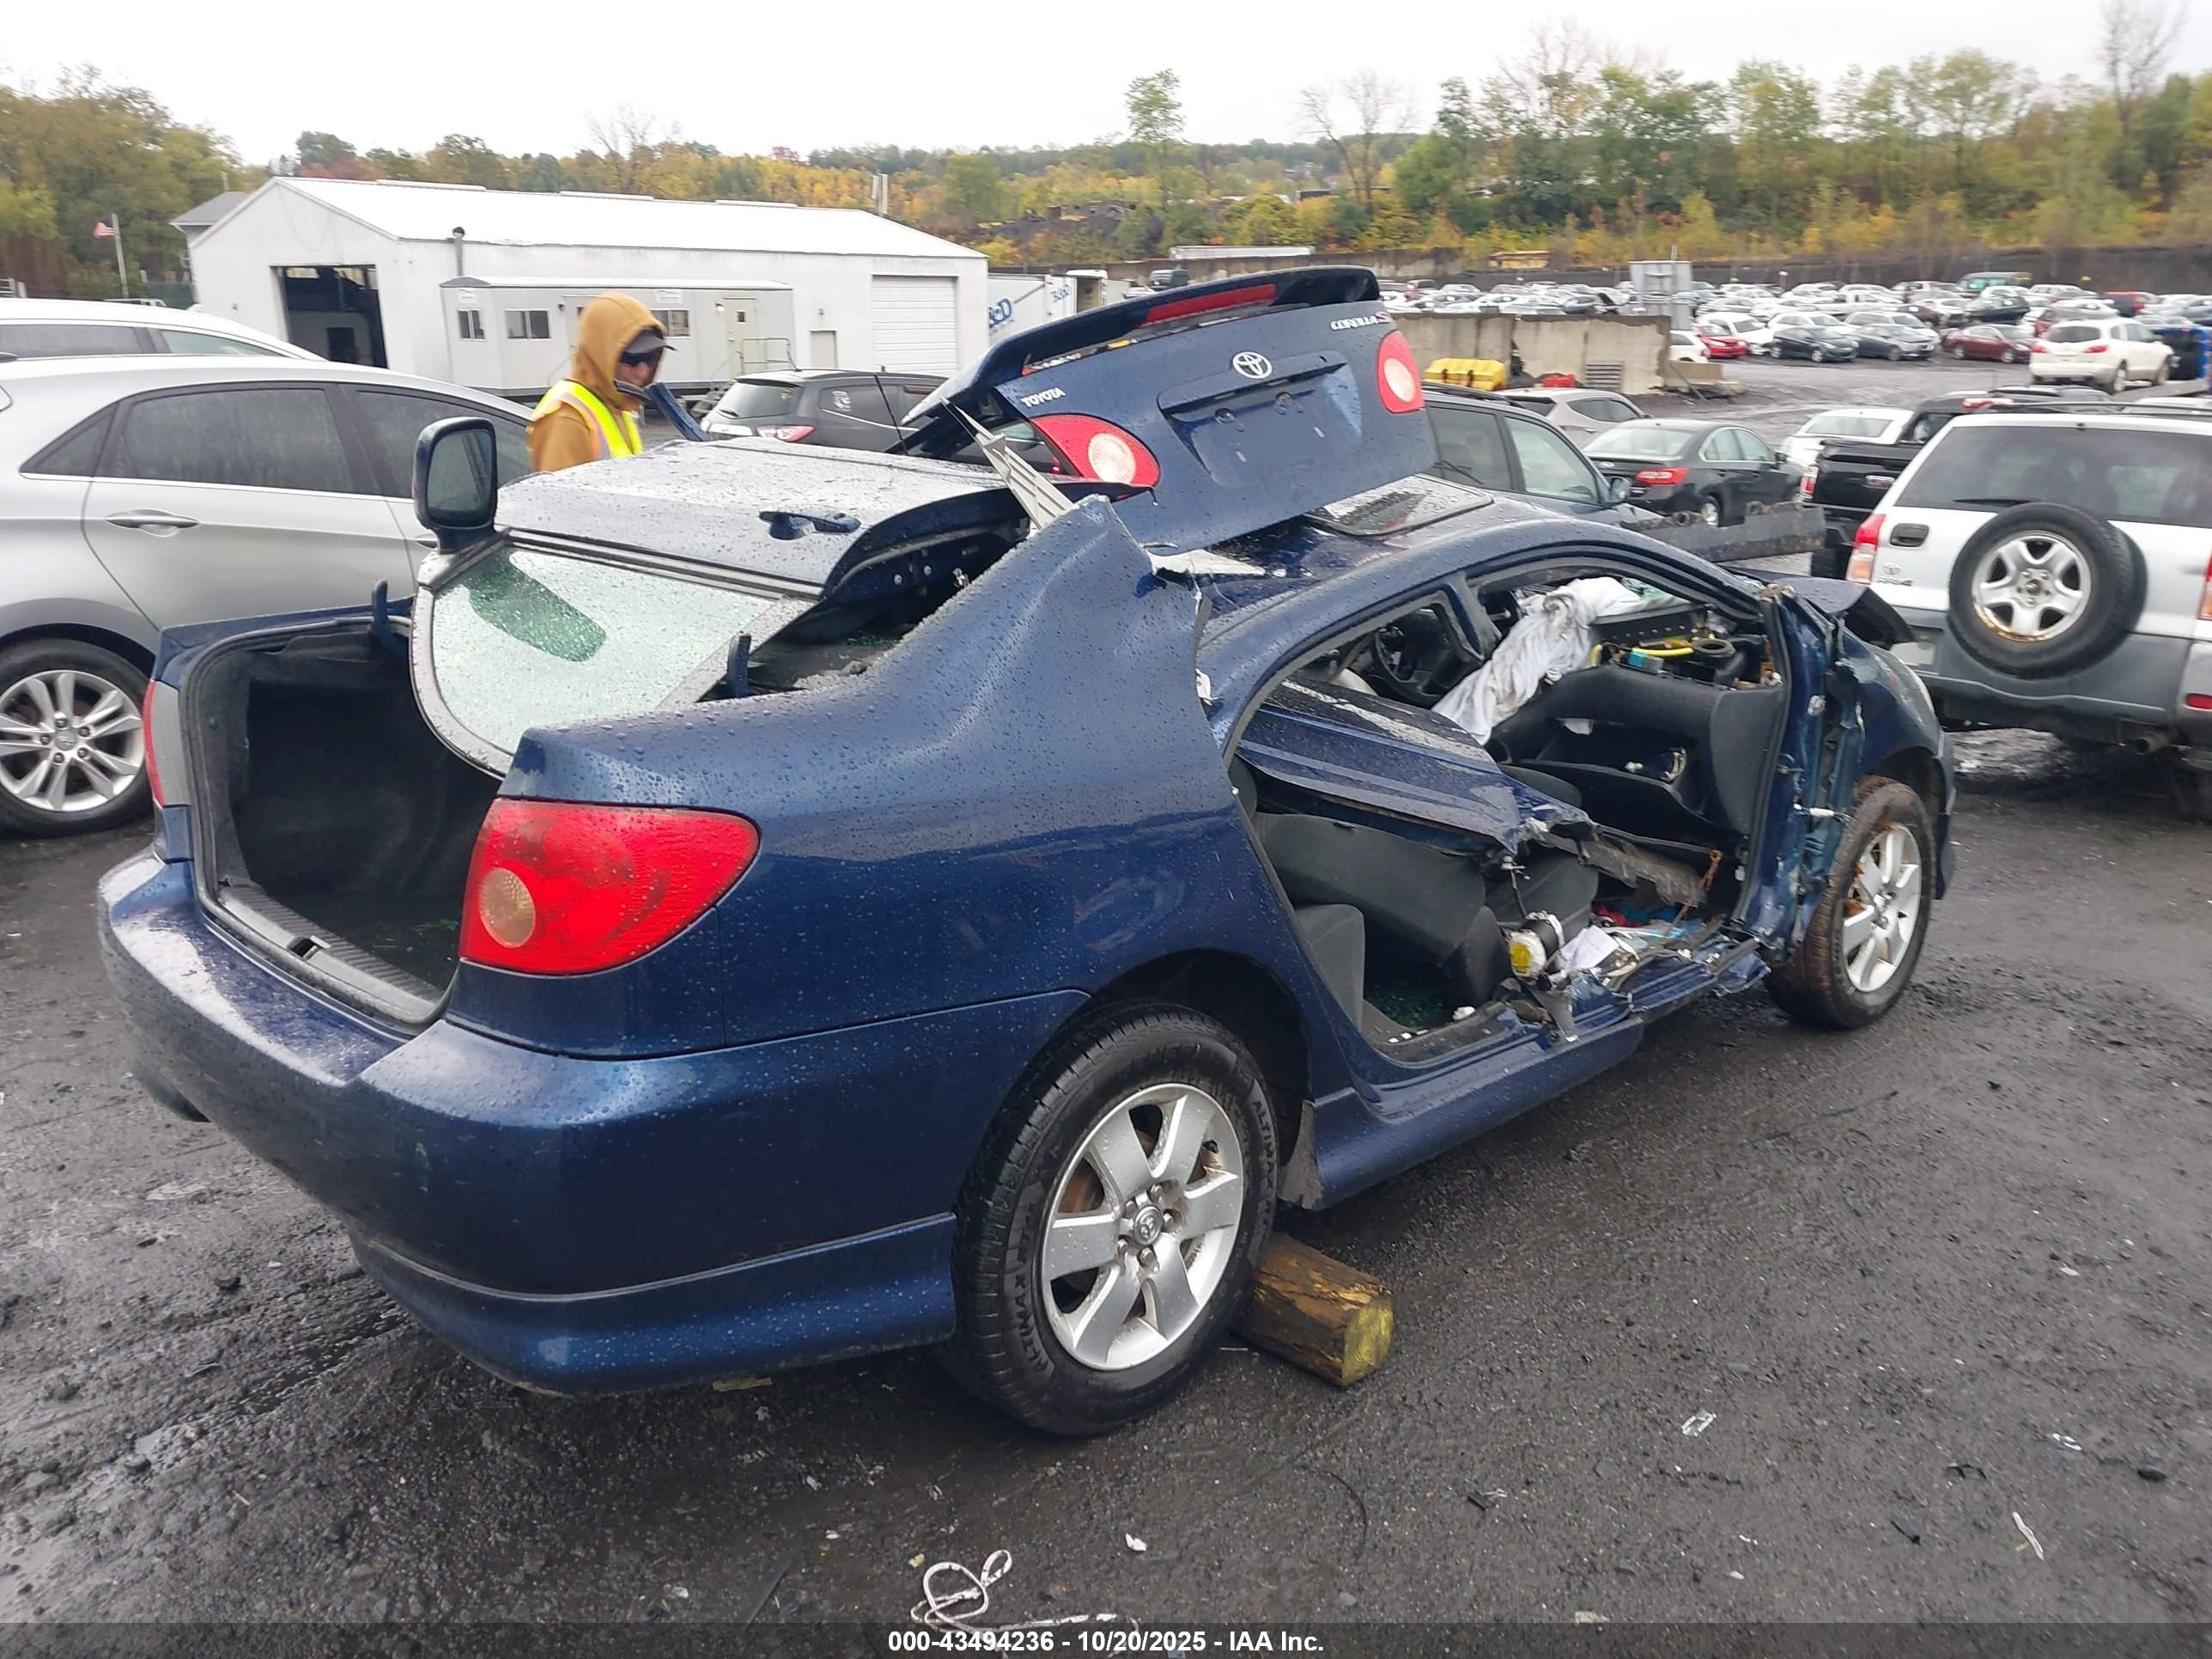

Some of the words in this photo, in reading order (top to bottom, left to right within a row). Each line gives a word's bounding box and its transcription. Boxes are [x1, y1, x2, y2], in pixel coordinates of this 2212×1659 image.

[1375, 311, 1389, 324] S
[1020, 387, 1066, 408] TOYOTA
[1252, 1100, 1273, 1189] ALTIMAX
[1014, 1273, 1049, 1373] ALTIMAX
